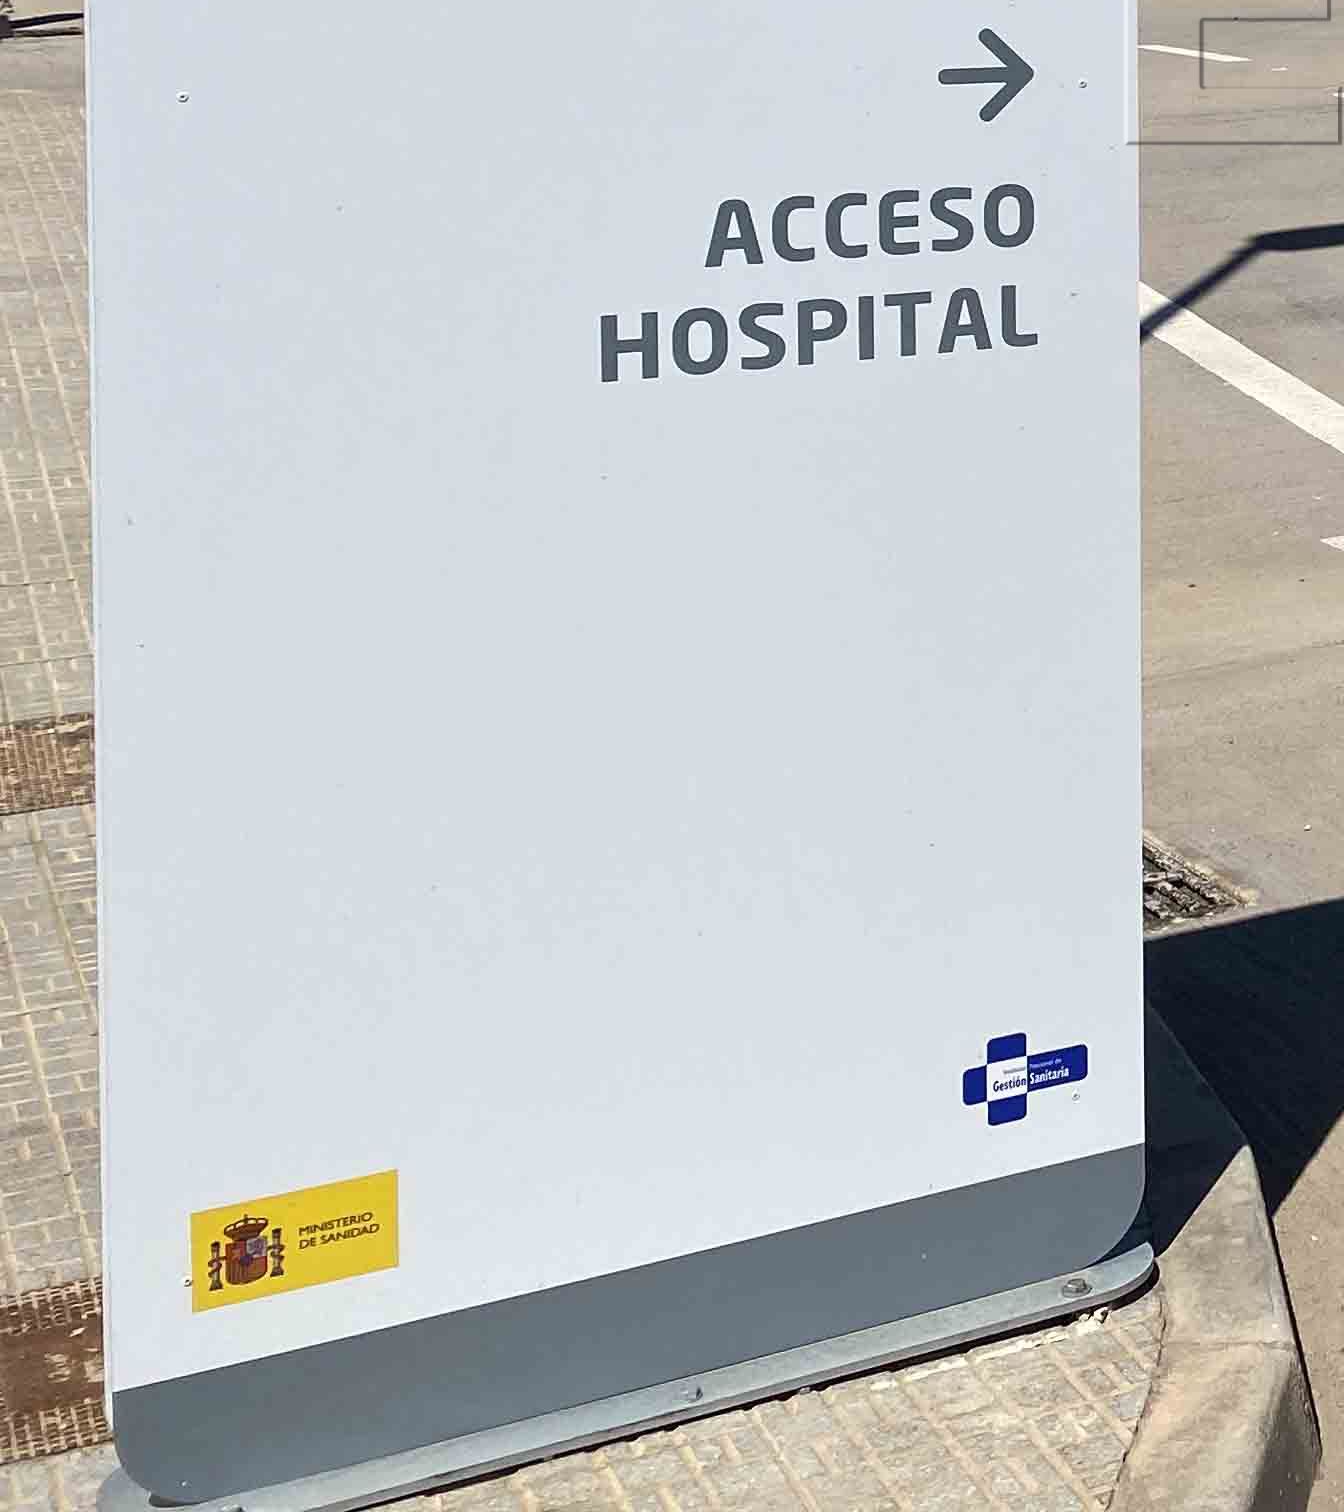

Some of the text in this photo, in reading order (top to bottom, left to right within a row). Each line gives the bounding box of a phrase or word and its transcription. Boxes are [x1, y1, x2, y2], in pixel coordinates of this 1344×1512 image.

[704, 183, 1036, 268] ACCESO
[599, 284, 1039, 383] HOSPITAL
[992, 1066, 1070, 1093] Gestión Sanitaria
[298, 1211, 374, 1237] MINISTERIO
[298, 1223, 380, 1250] DE SANIDAD
